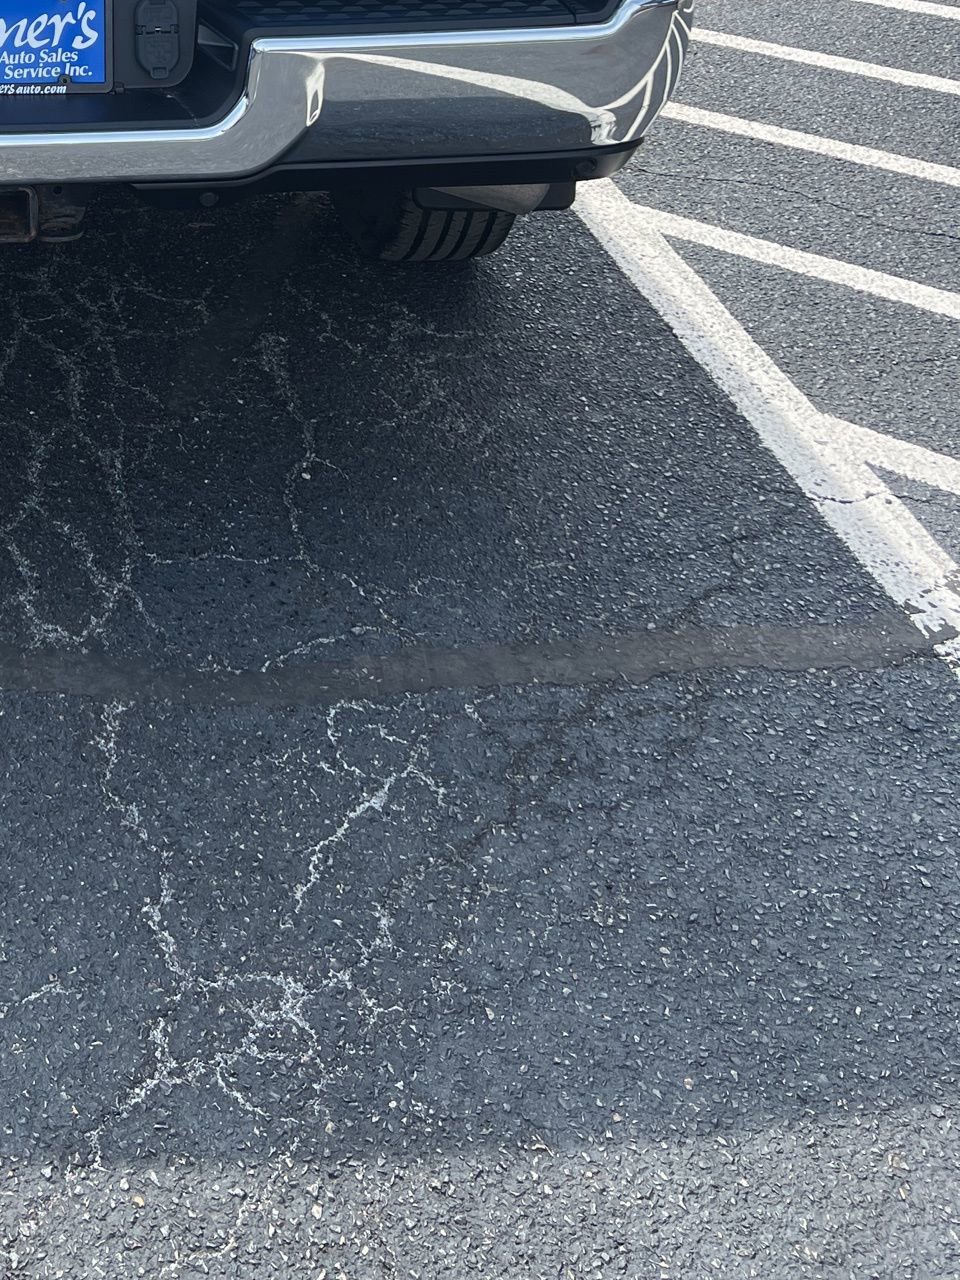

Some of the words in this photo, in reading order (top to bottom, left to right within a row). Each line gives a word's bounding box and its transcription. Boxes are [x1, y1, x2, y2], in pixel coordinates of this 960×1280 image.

[38, 48, 78, 63] Sales
[4, 63, 60, 80] Service
[64, 62, 93, 77] Inc.
